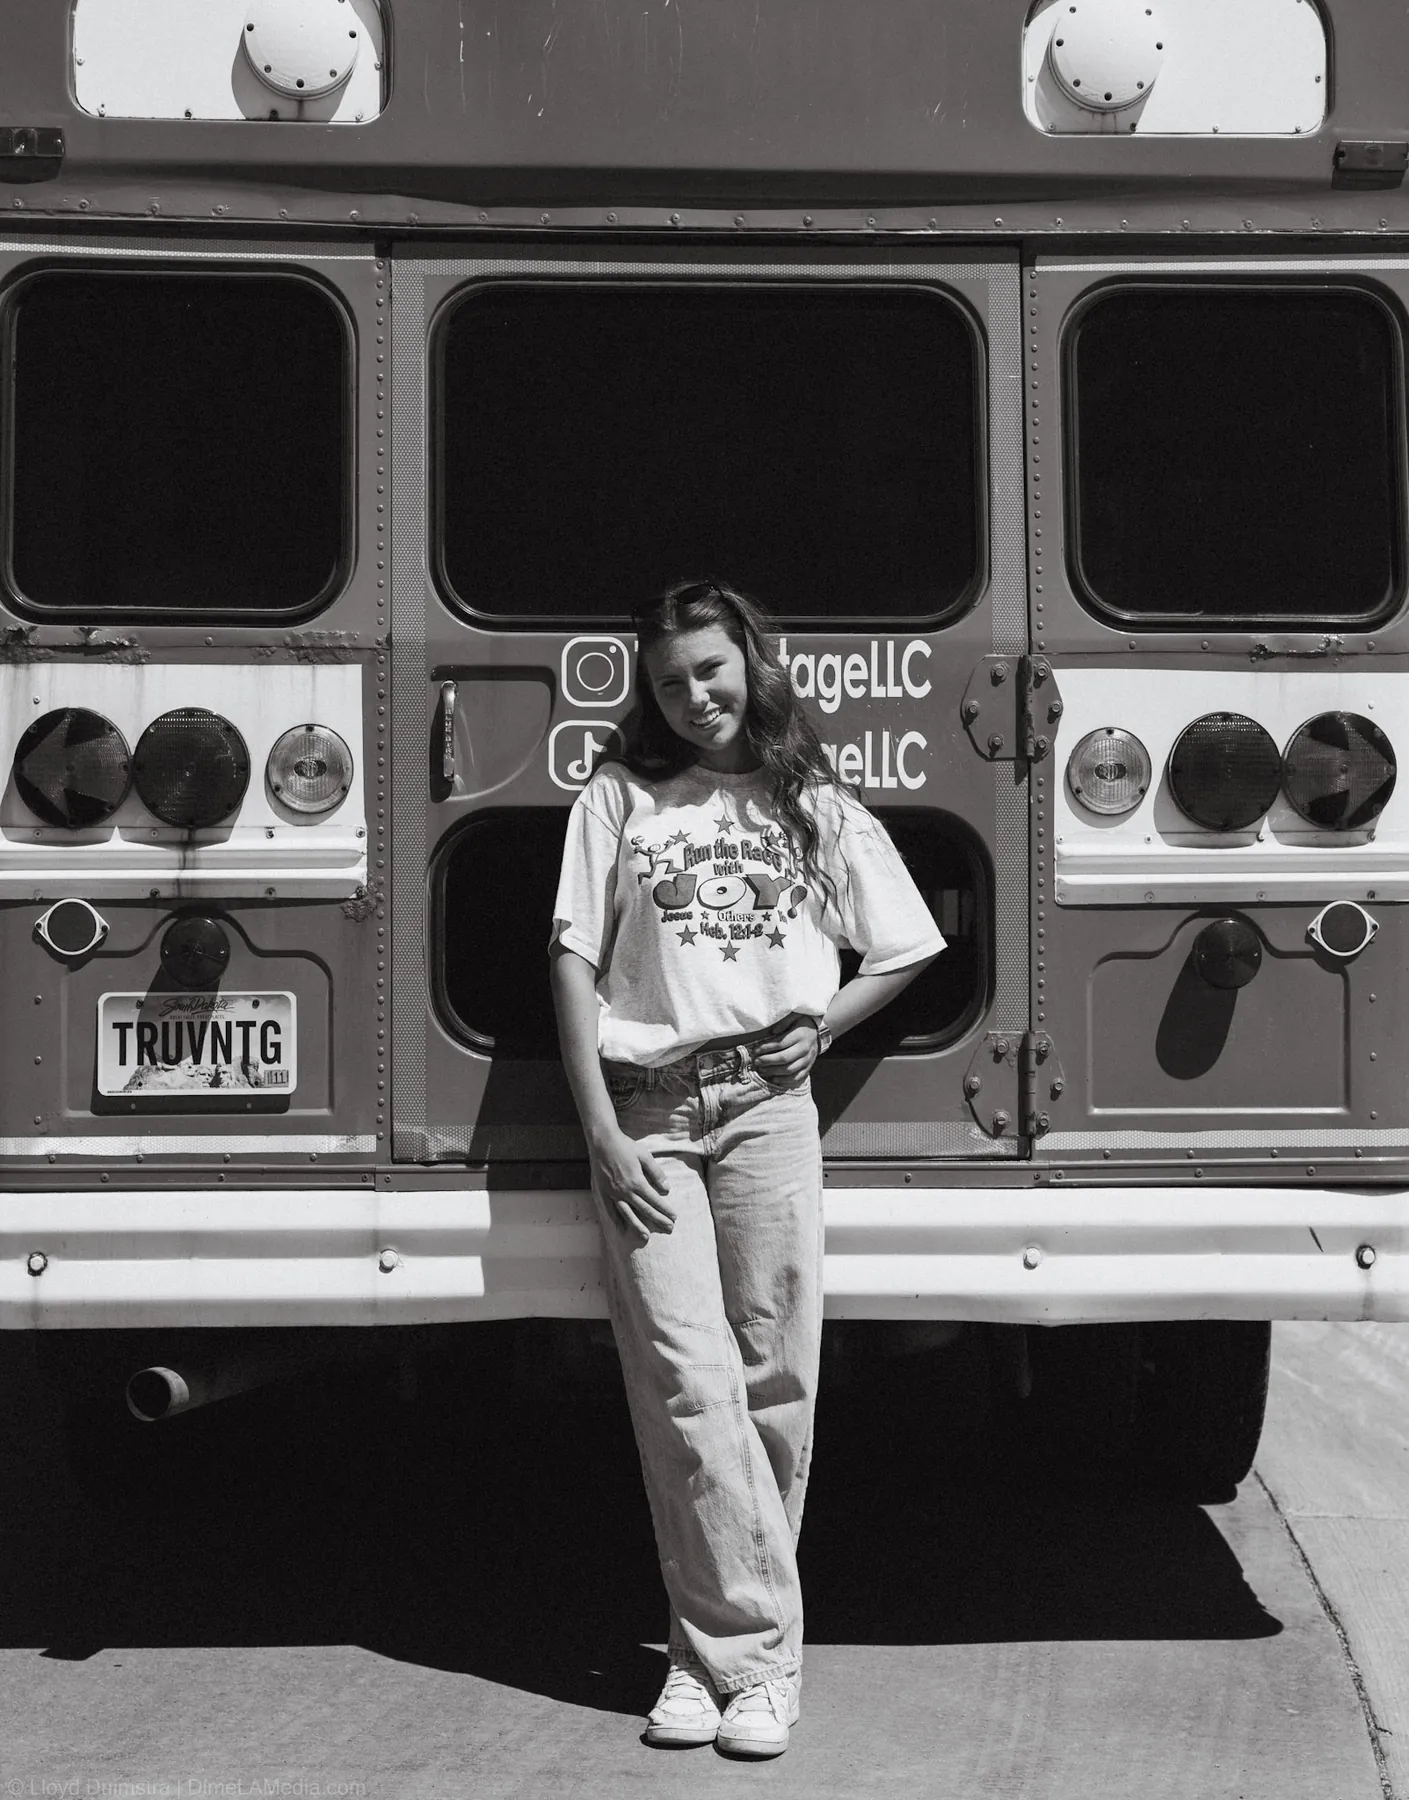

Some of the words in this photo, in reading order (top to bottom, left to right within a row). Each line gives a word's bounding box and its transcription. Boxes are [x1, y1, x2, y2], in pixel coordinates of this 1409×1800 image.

[683, 842, 713, 872] Run
[713, 837, 739, 860] the
[740, 838, 783, 873] Race
[660, 910, 694, 923] Jesus
[717, 910, 755, 922] Others
[699, 921, 728, 940] Heb.
[728, 922, 764, 940] 12:1-2
[111, 1019, 282, 1066] TRUVNTG
